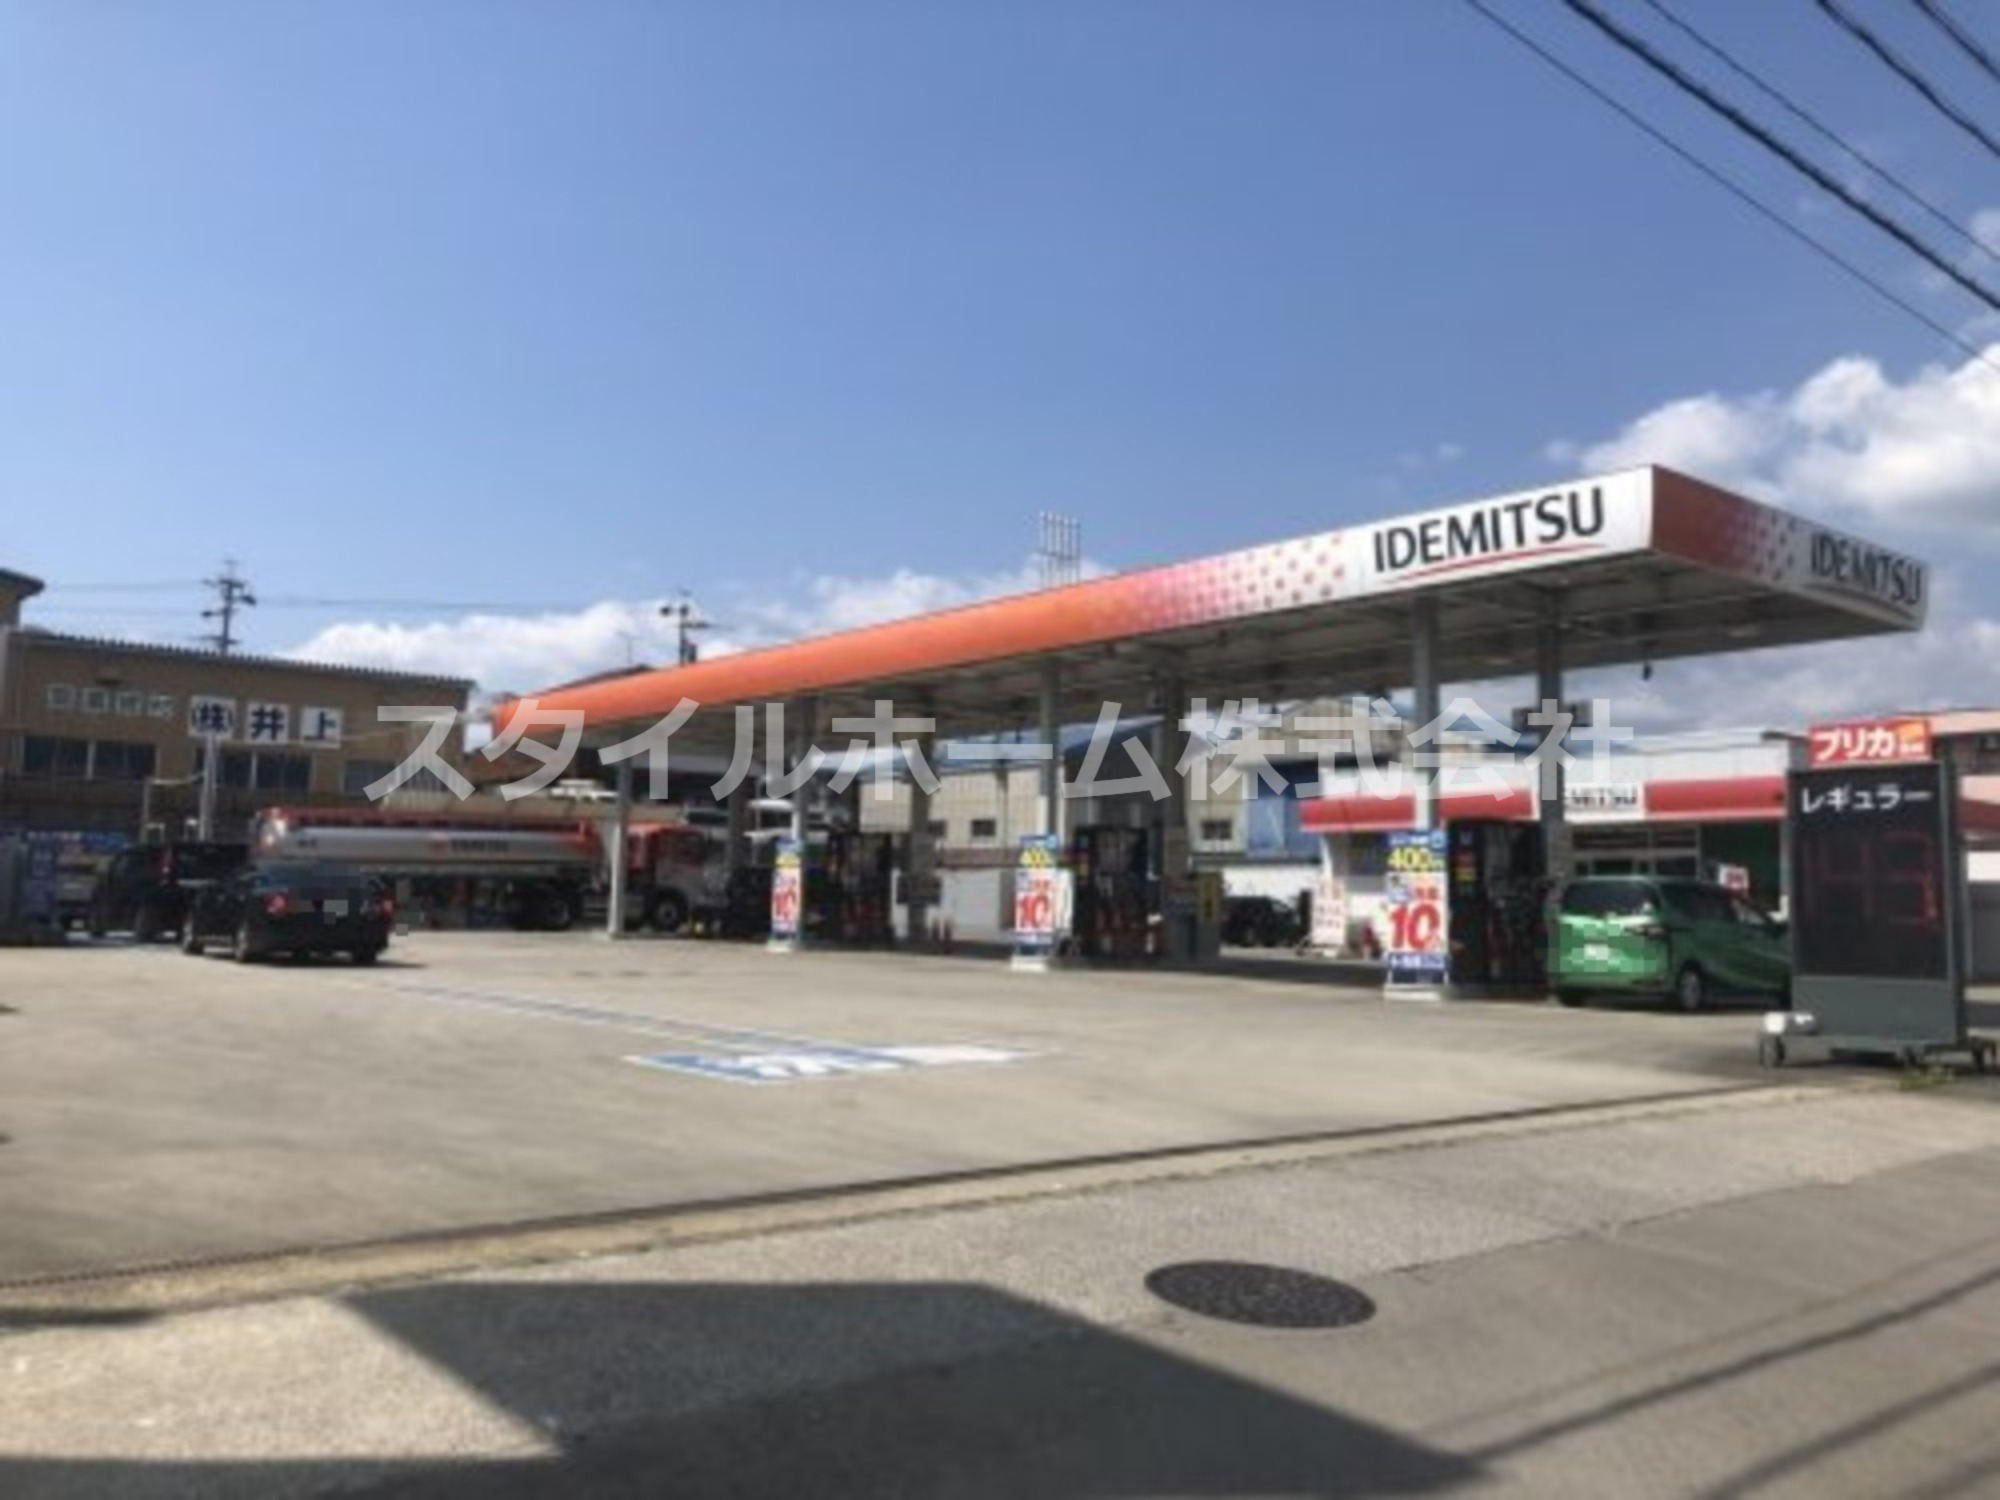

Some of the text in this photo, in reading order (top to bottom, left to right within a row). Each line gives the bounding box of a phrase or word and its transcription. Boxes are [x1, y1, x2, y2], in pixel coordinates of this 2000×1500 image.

[1374, 486, 1605, 573] IDEMITSU
[1810, 528, 1921, 605] IDEMITSU
[1802, 783, 1933, 813] レギュラー
[1390, 903, 1440, 950] 10
